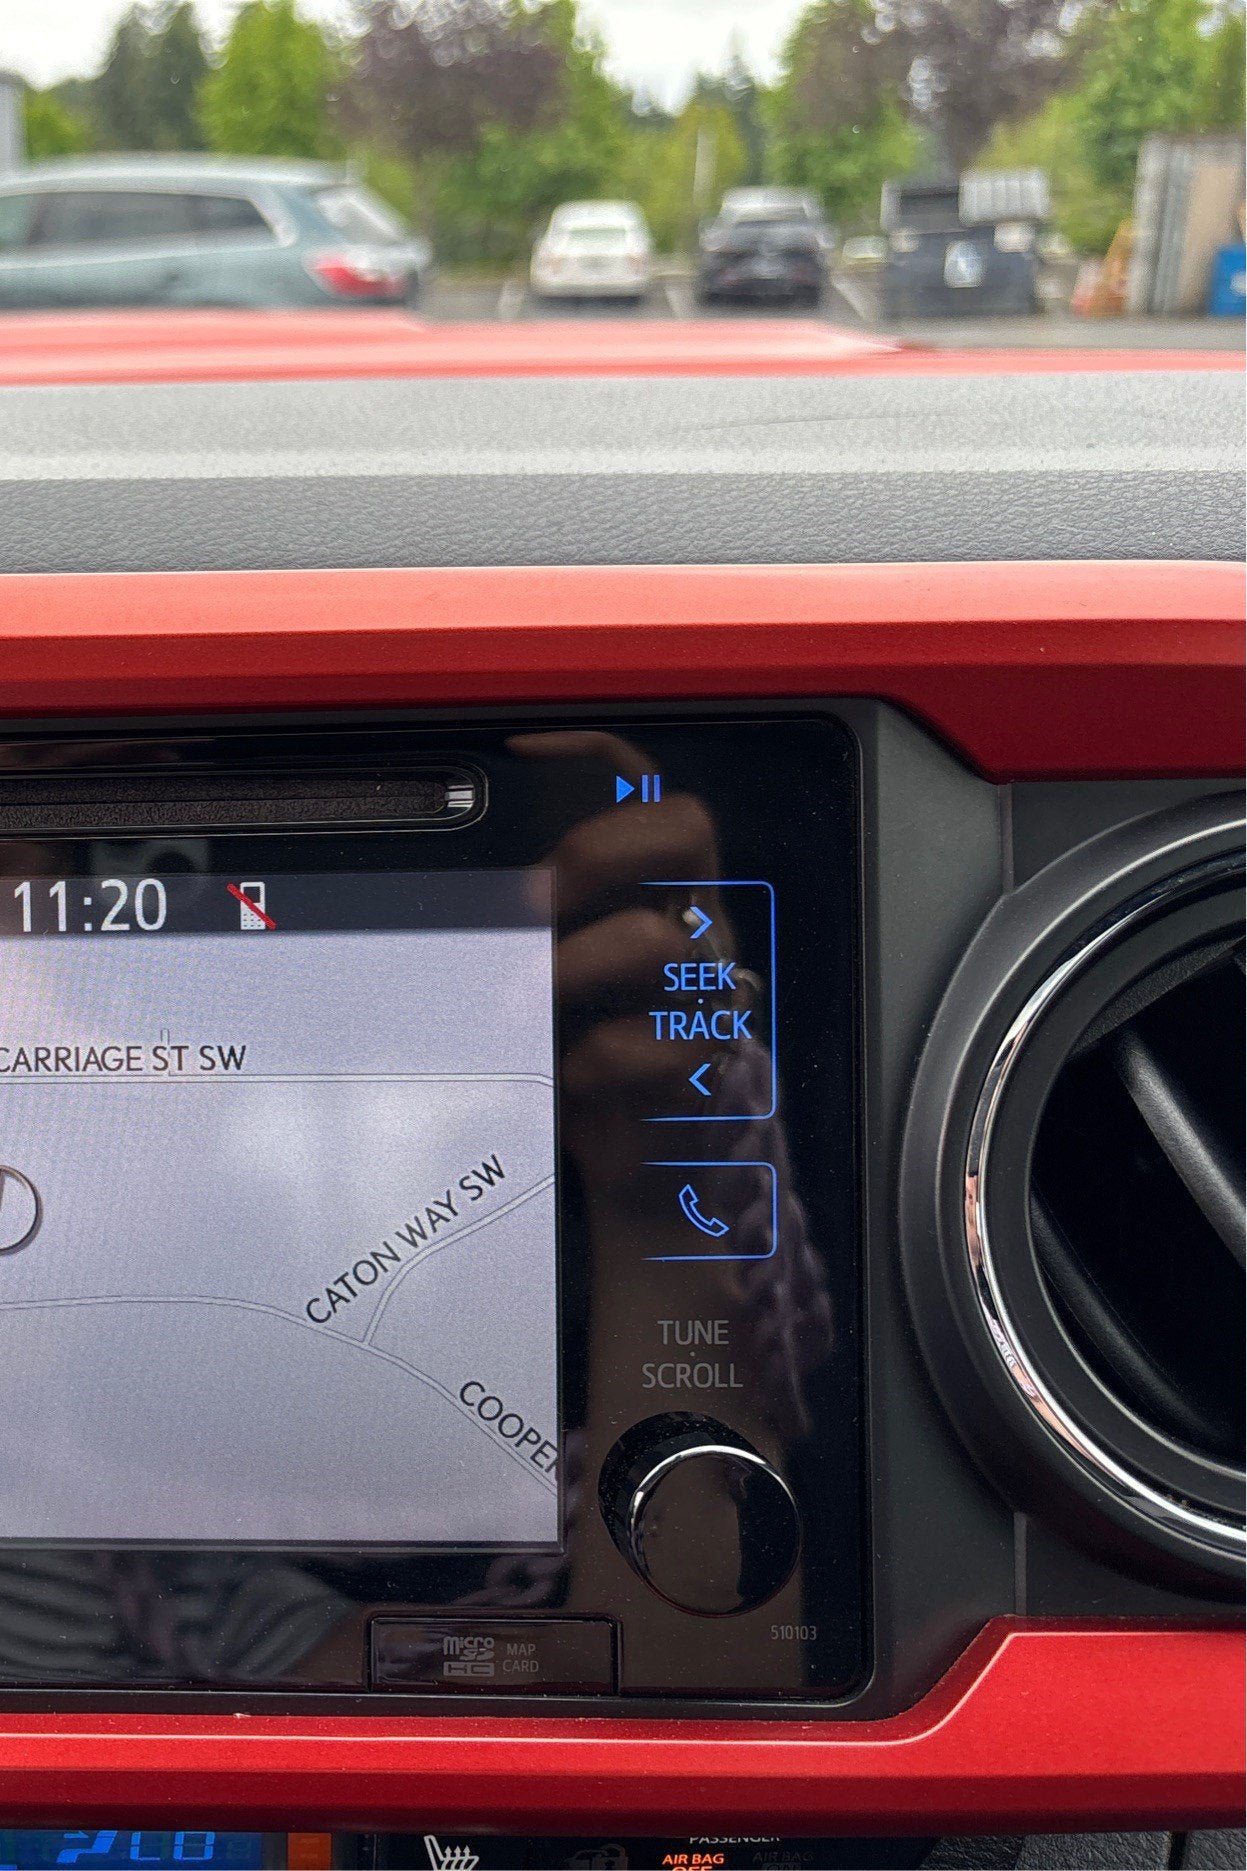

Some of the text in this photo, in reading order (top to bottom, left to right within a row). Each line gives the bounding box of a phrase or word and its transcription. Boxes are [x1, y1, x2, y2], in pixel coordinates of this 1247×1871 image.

[12, 878, 167, 932] 11:20
[663, 961, 737, 991] SEEK
[649, 1010, 753, 1041] TRACK
[152, 1046, 190, 1071] ST
[199, 1045, 247, 1071] SW
[305, 1153, 506, 1324] CATON WAY SW
[657, 1319, 730, 1346] TUNE
[641, 1362, 744, 1390] SCROLL
[770, 1624, 818, 1641] 510103
[506, 1643, 537, 1657] MAP
[502, 1660, 540, 1673] CARD
[662, 1853, 726, 1865] AIR BAG
